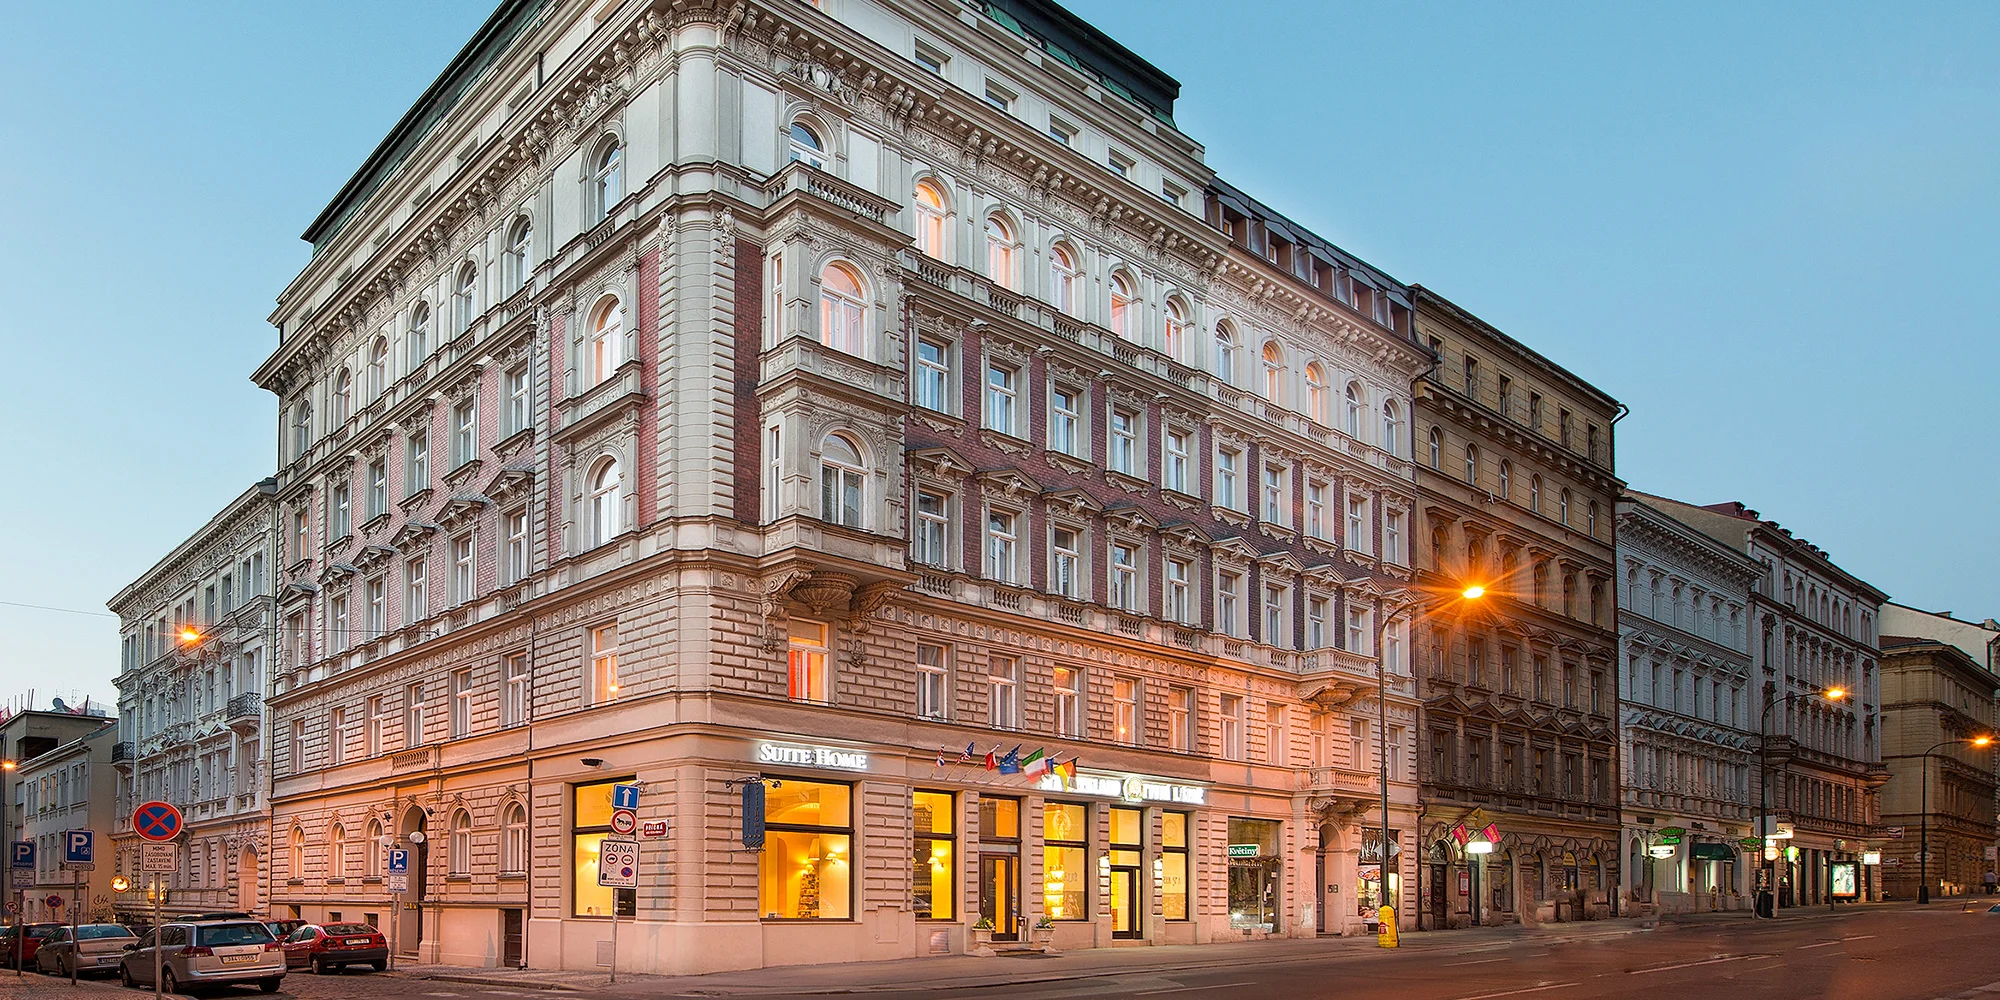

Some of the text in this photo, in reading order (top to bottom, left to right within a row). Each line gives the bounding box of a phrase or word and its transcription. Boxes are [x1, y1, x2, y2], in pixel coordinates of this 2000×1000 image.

[760, 743, 868, 769] SUITE HOME
[71, 833, 88, 853] P
[605, 842, 634, 853] ZÓNA
[16, 845, 31, 861] P
[393, 851, 404, 865] P
[1228, 846, 1257, 857] Květiny
